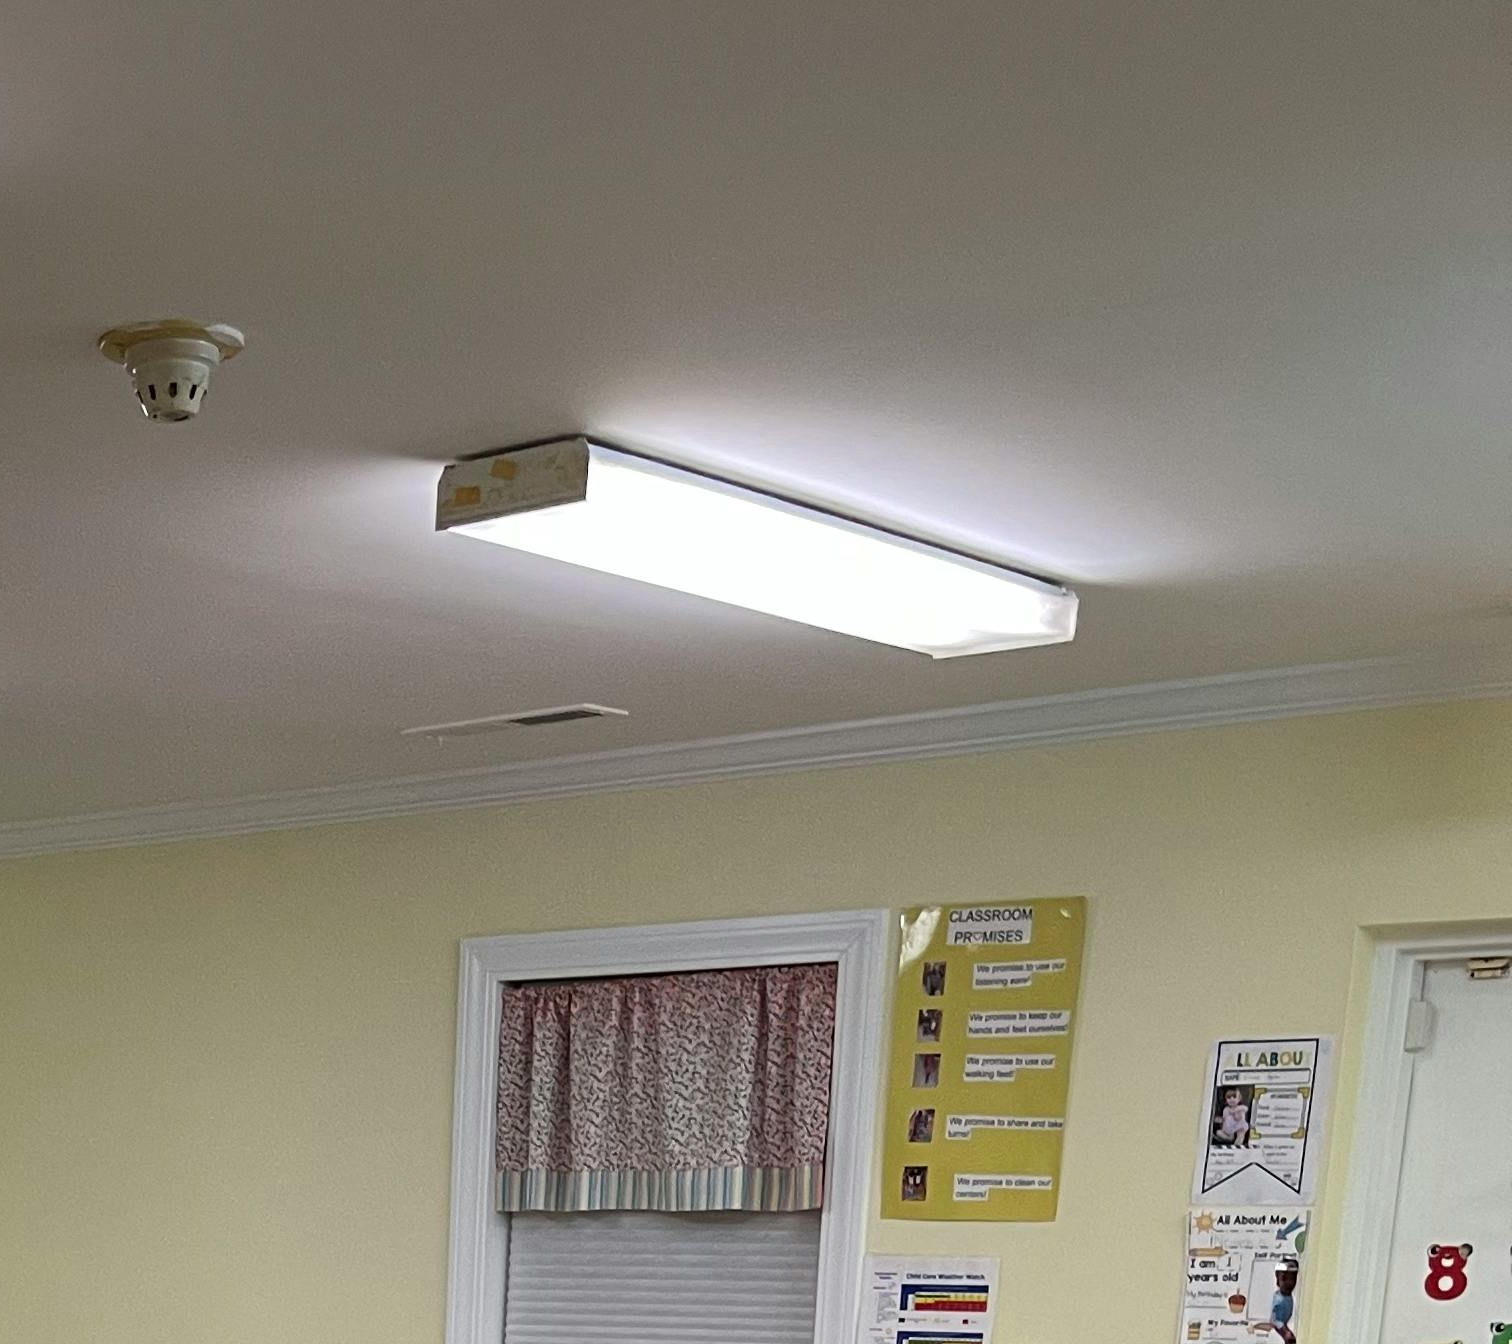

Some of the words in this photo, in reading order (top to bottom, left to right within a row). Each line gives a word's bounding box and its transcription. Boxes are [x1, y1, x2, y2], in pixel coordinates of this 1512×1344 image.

[949, 908, 1033, 923] CLASSROOM
[1217, 1215, 1230, 1225] All
[1234, 1215, 1266, 1225] About
[1269, 1216, 1287, 1225] Me
[1199, 1260, 1216, 1268] am
[1187, 1273, 1218, 1283] years
[1222, 1272, 1239, 1282] old
[1424, 1245, 1468, 1301] 8
